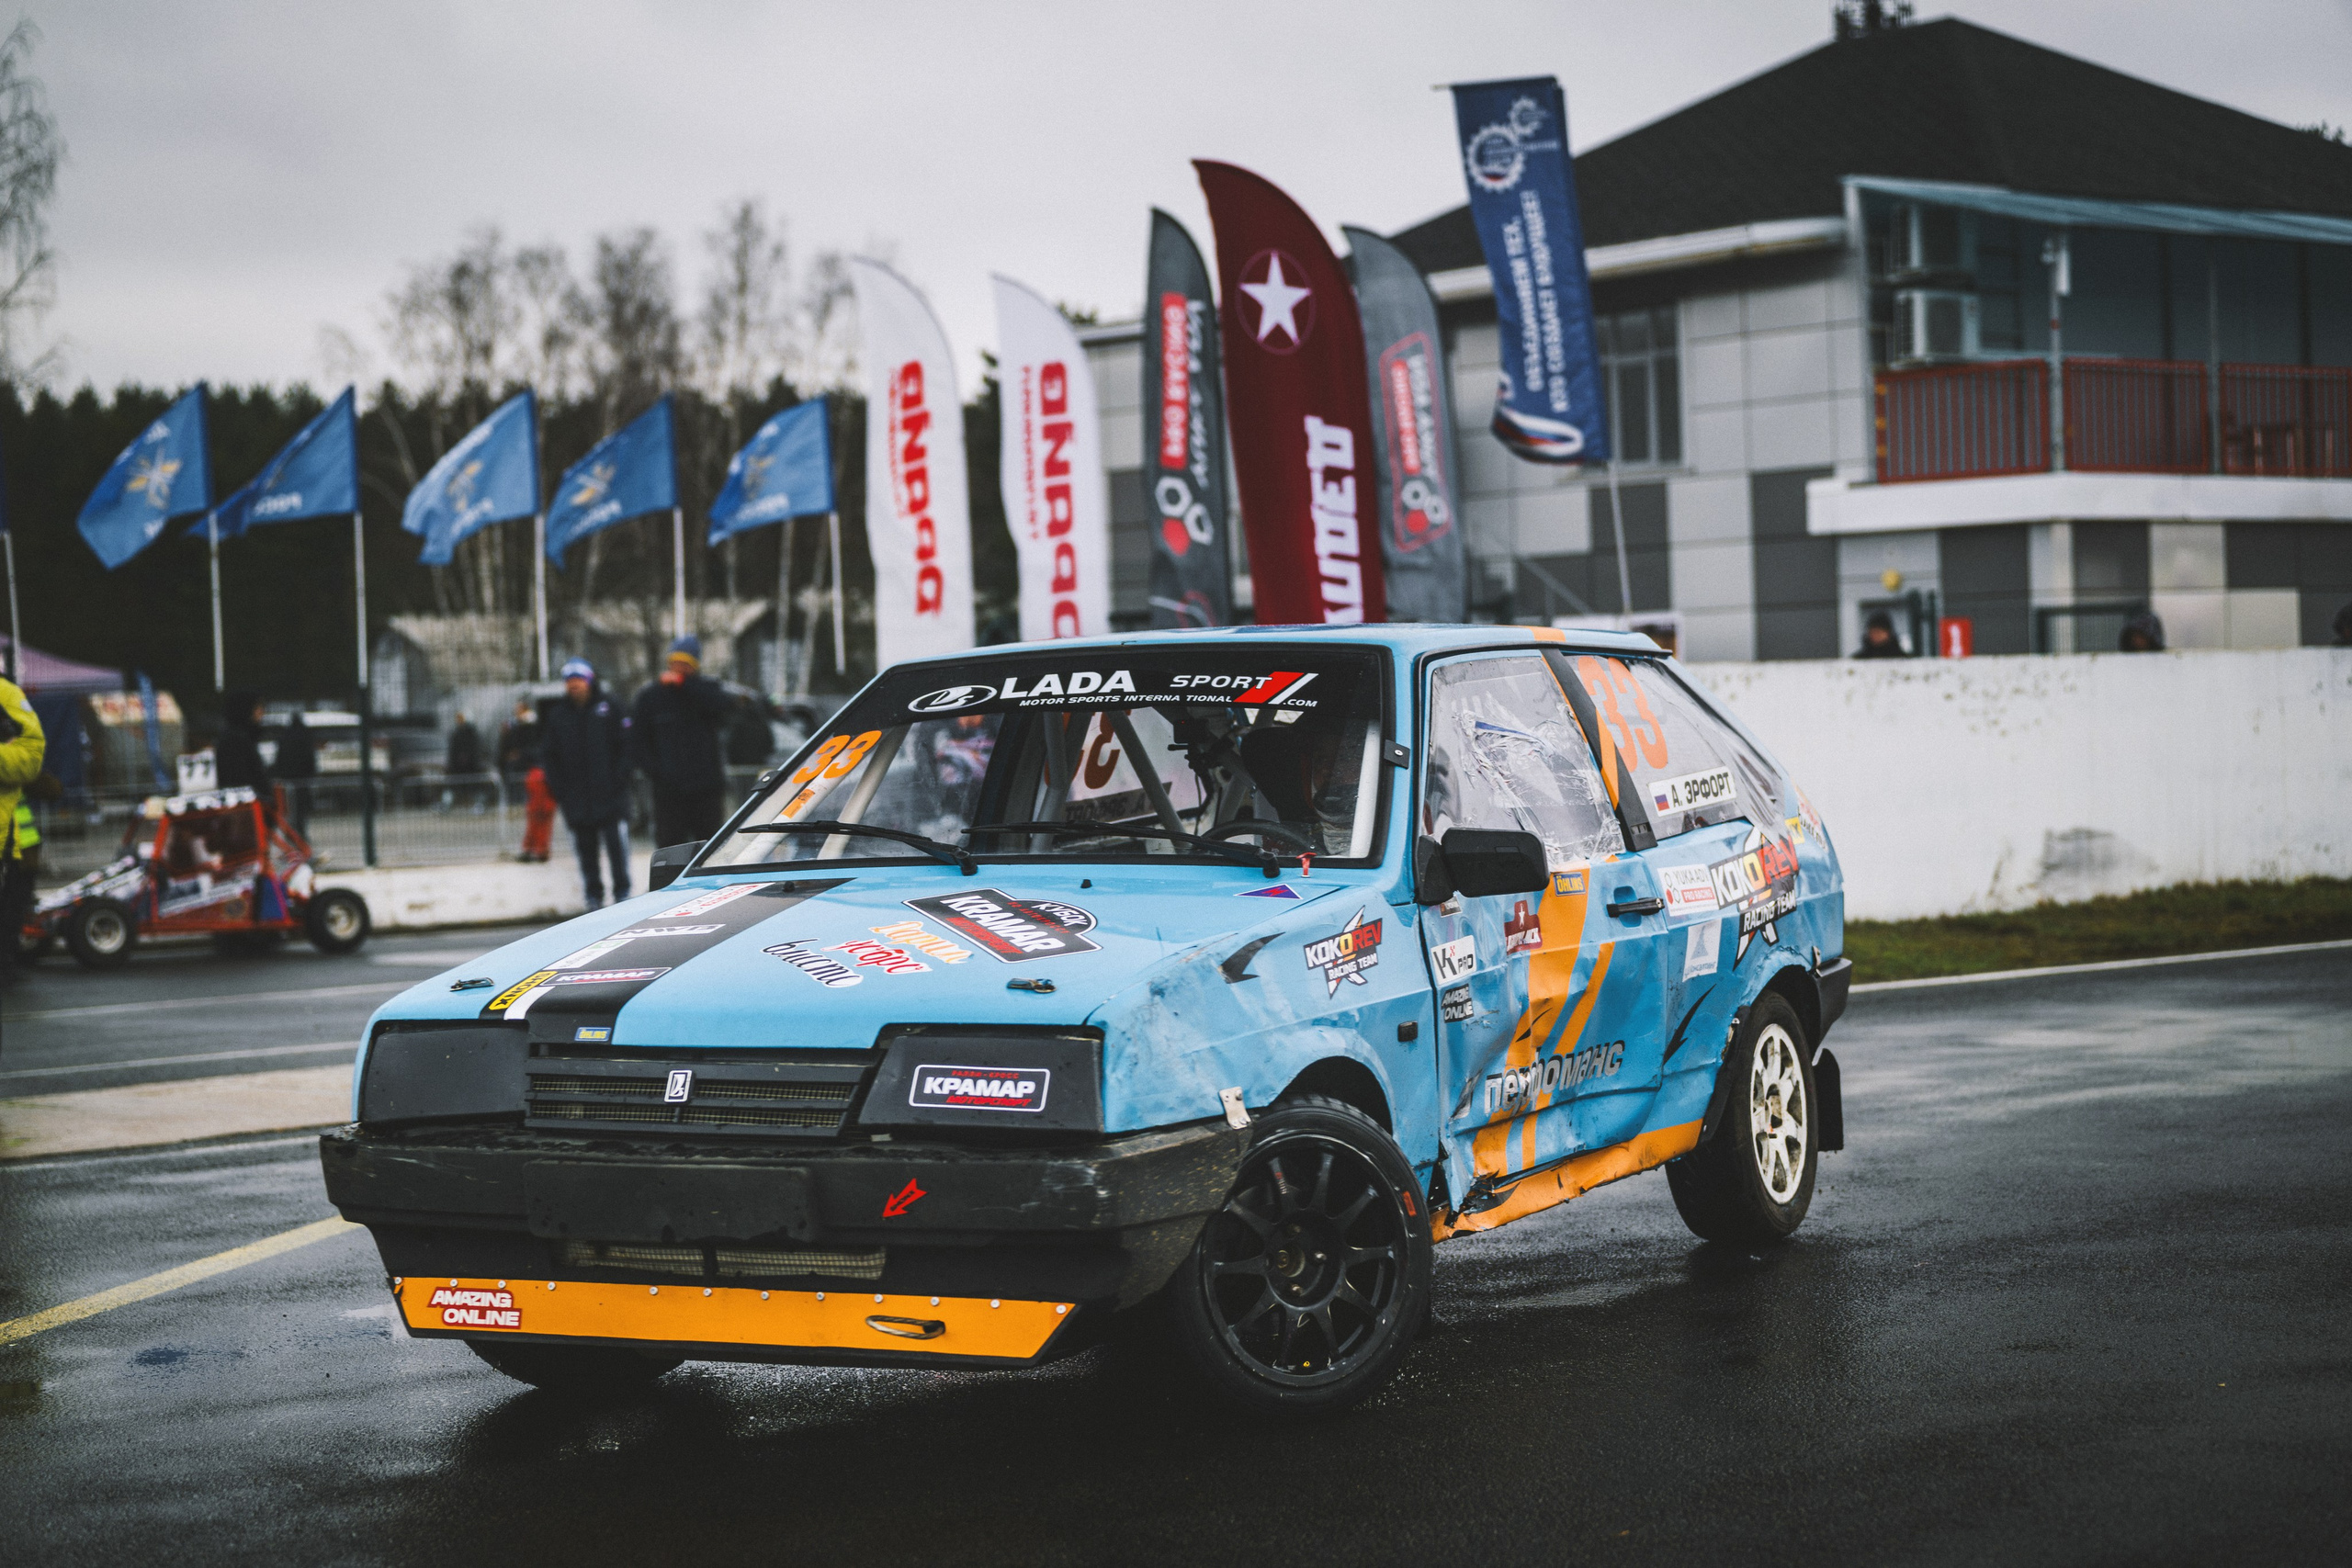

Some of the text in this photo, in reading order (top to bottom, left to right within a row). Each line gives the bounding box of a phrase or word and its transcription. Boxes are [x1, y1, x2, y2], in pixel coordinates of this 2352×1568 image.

[1000, 670, 1272, 699] LADA SPORT
[1019, 698, 1064, 706] MOTOR
[1068, 695, 1120, 704] SPORTS
[1283, 698, 1317, 707] .COM
[1577, 656, 1668, 773] 33
[792, 730, 882, 784] 33
[1670, 772, 1733, 808] А. ЭРФОРТ
[1556, 875, 1584, 892] ÖHLINS
[1711, 835, 1799, 907] KOKOREV
[939, 895, 1066, 953] KRAMAR
[1031, 903, 1088, 926] КУБОК
[1744, 890, 1796, 932] RACING TEAM
[1305, 921, 1382, 968] KOKOREV
[1329, 953, 1378, 979] RACING TEAM
[923, 1077, 1036, 1098] КРАМАР
[945, 1095, 1032, 1107] МОТОРСПОРТ
[431, 1290, 513, 1308] AMAZING
[443, 1308, 520, 1326] ONLINE
